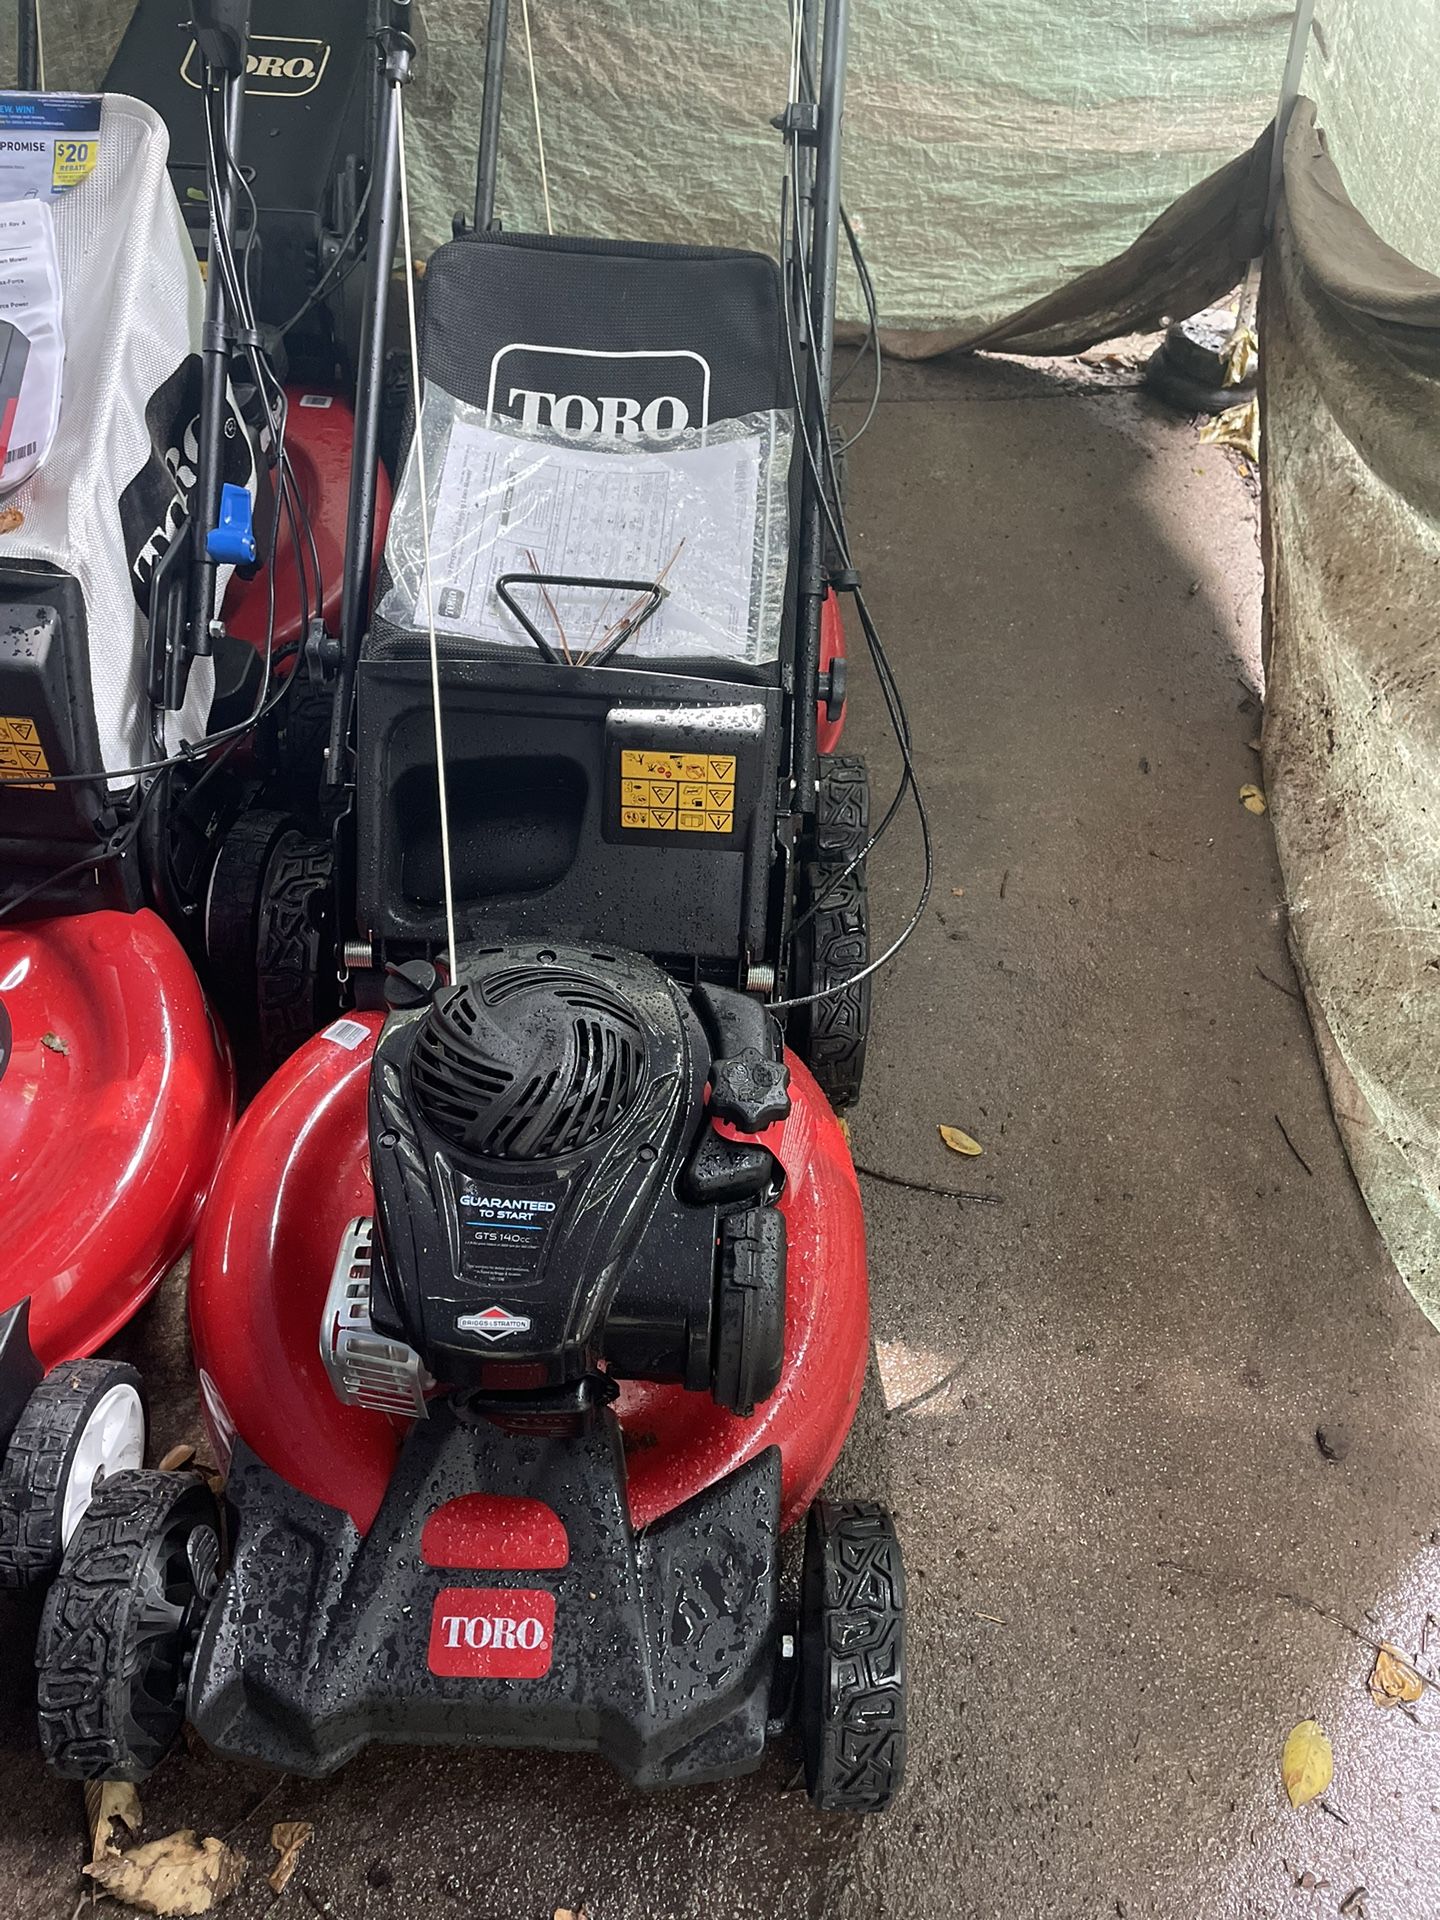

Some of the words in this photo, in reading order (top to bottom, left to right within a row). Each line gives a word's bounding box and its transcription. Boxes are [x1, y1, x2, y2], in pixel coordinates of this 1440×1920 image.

[58, 143, 89, 163] $20
[508, 388, 688, 442] TORO
[460, 1195, 555, 1212] GUARANTEED
[479, 1209, 494, 1217] TO
[497, 1211, 534, 1220] START
[475, 1232, 497, 1241] GTS
[441, 1616, 546, 1650] TORO
